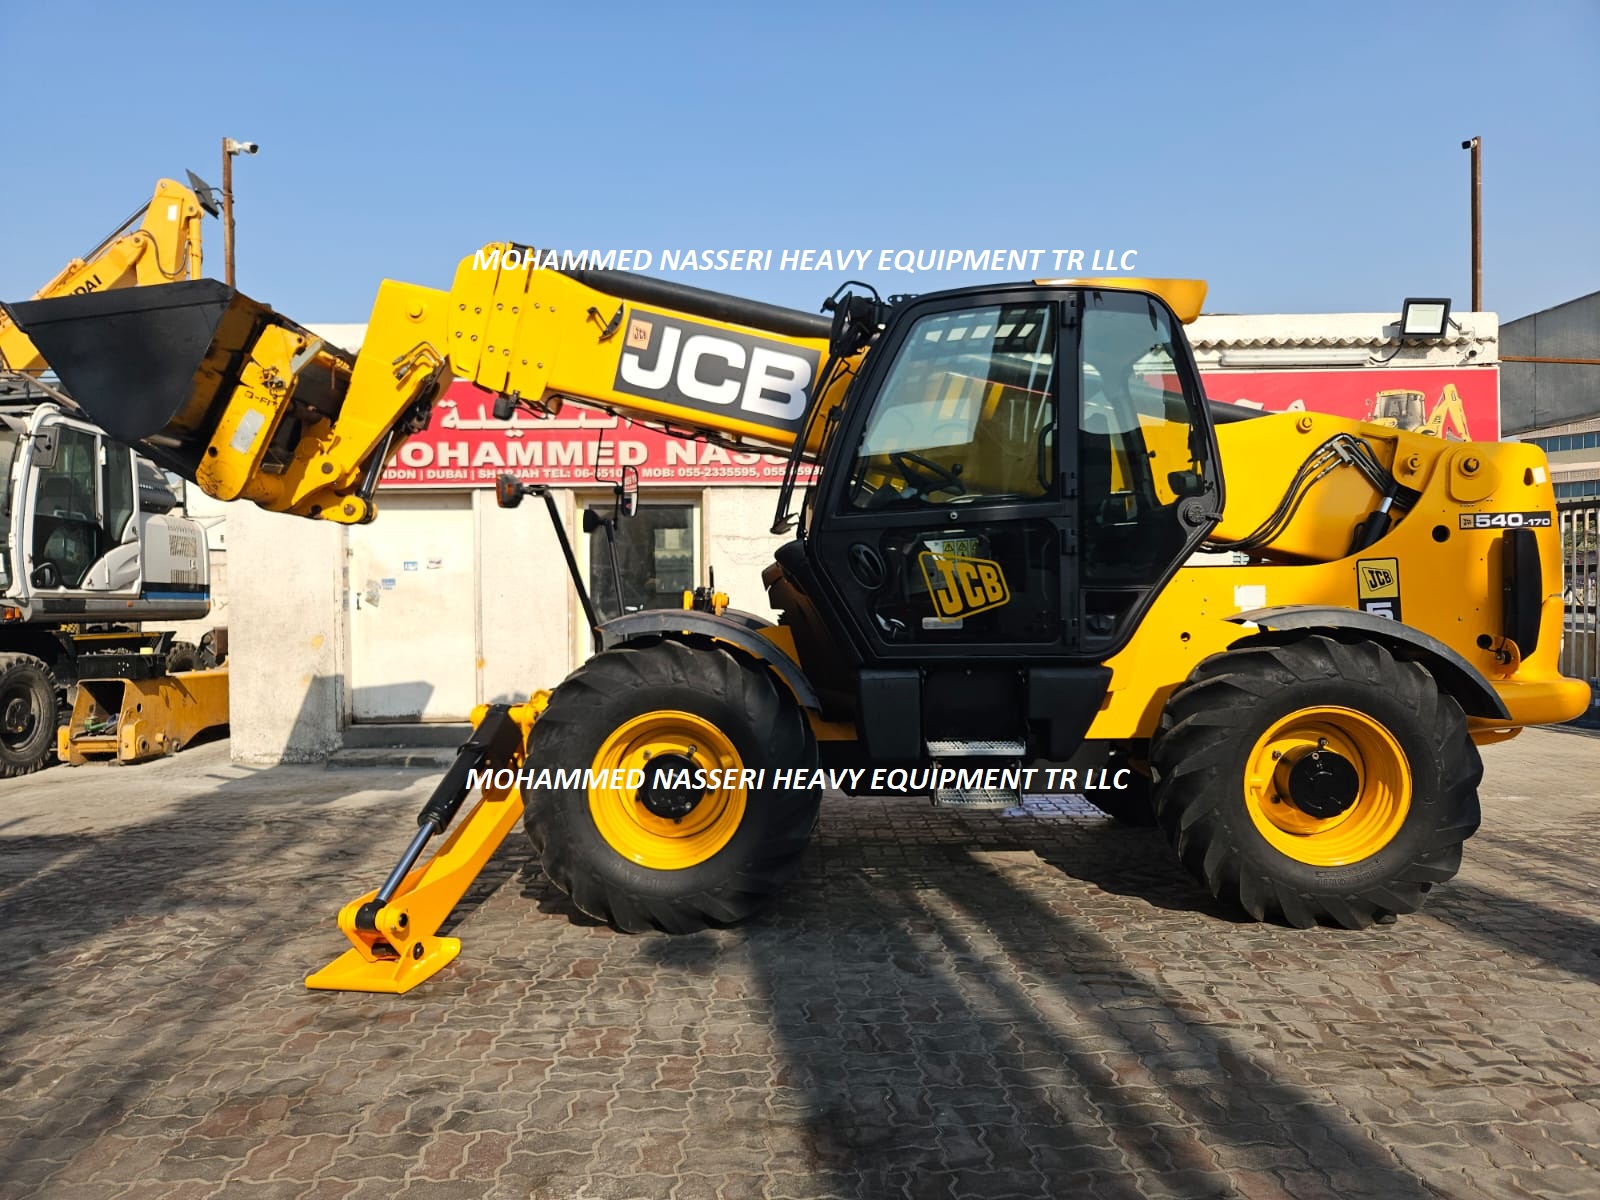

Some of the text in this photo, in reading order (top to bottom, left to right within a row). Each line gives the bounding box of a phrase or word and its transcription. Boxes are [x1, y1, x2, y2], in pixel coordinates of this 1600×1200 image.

[70, 274, 102, 296] DAI
[620, 325, 812, 421] JCB
[426, 469, 468, 479] DUBAI
[543, 468, 571, 479] TEL:
[642, 466, 675, 478] MOB:
[936, 560, 1004, 615] JCB
[1367, 569, 1392, 589] JCB
